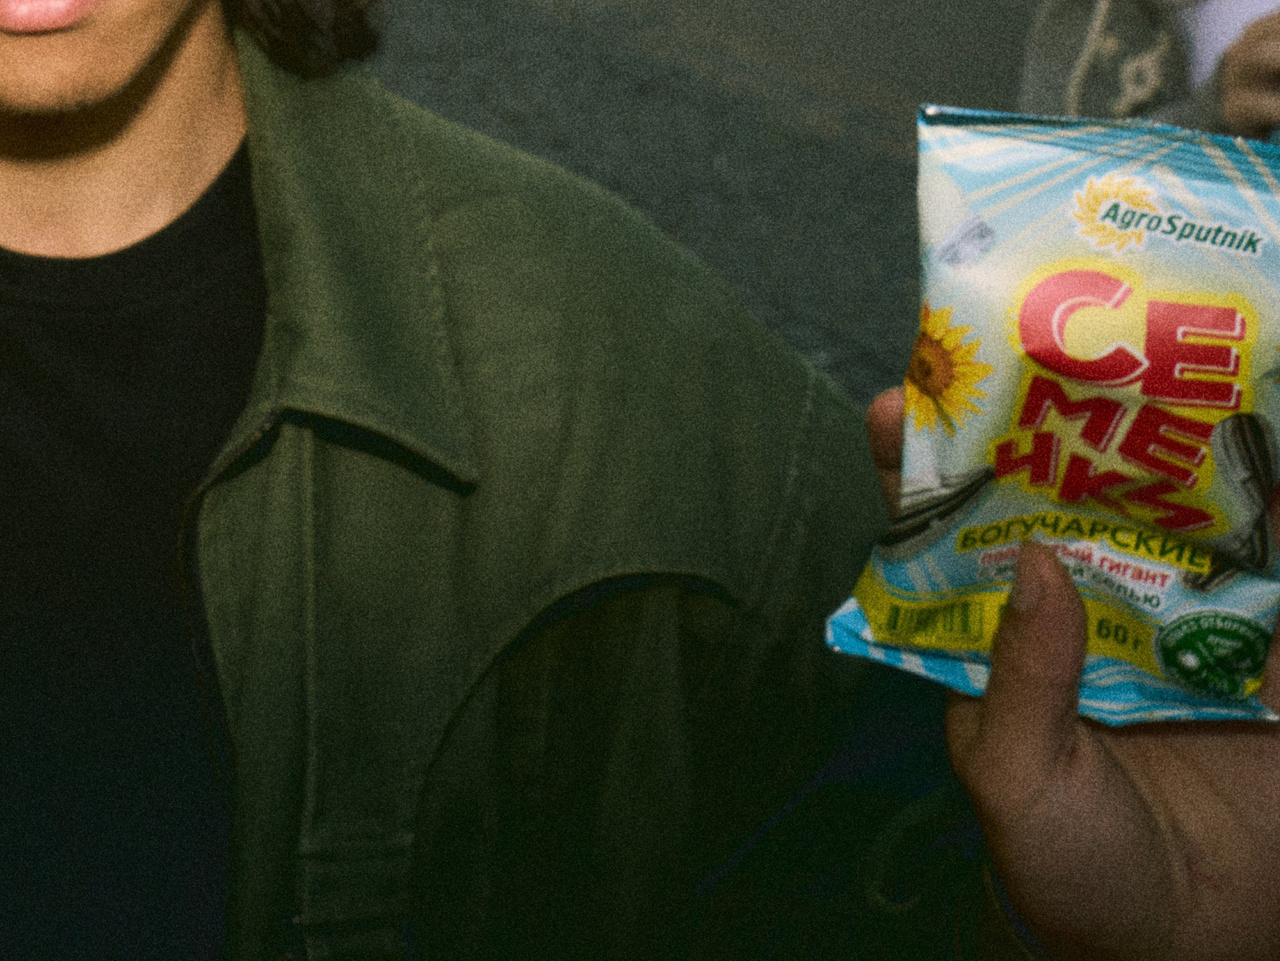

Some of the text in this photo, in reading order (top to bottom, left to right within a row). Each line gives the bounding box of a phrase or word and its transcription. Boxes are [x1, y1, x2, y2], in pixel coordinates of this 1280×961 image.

[1100, 201, 1263, 254] AgroSputnik
[960, 514, 1207, 570] БОГУЧАРСКИЕ
[1098, 555, 1170, 588] гигант
[1096, 618, 1128, 646] 60
